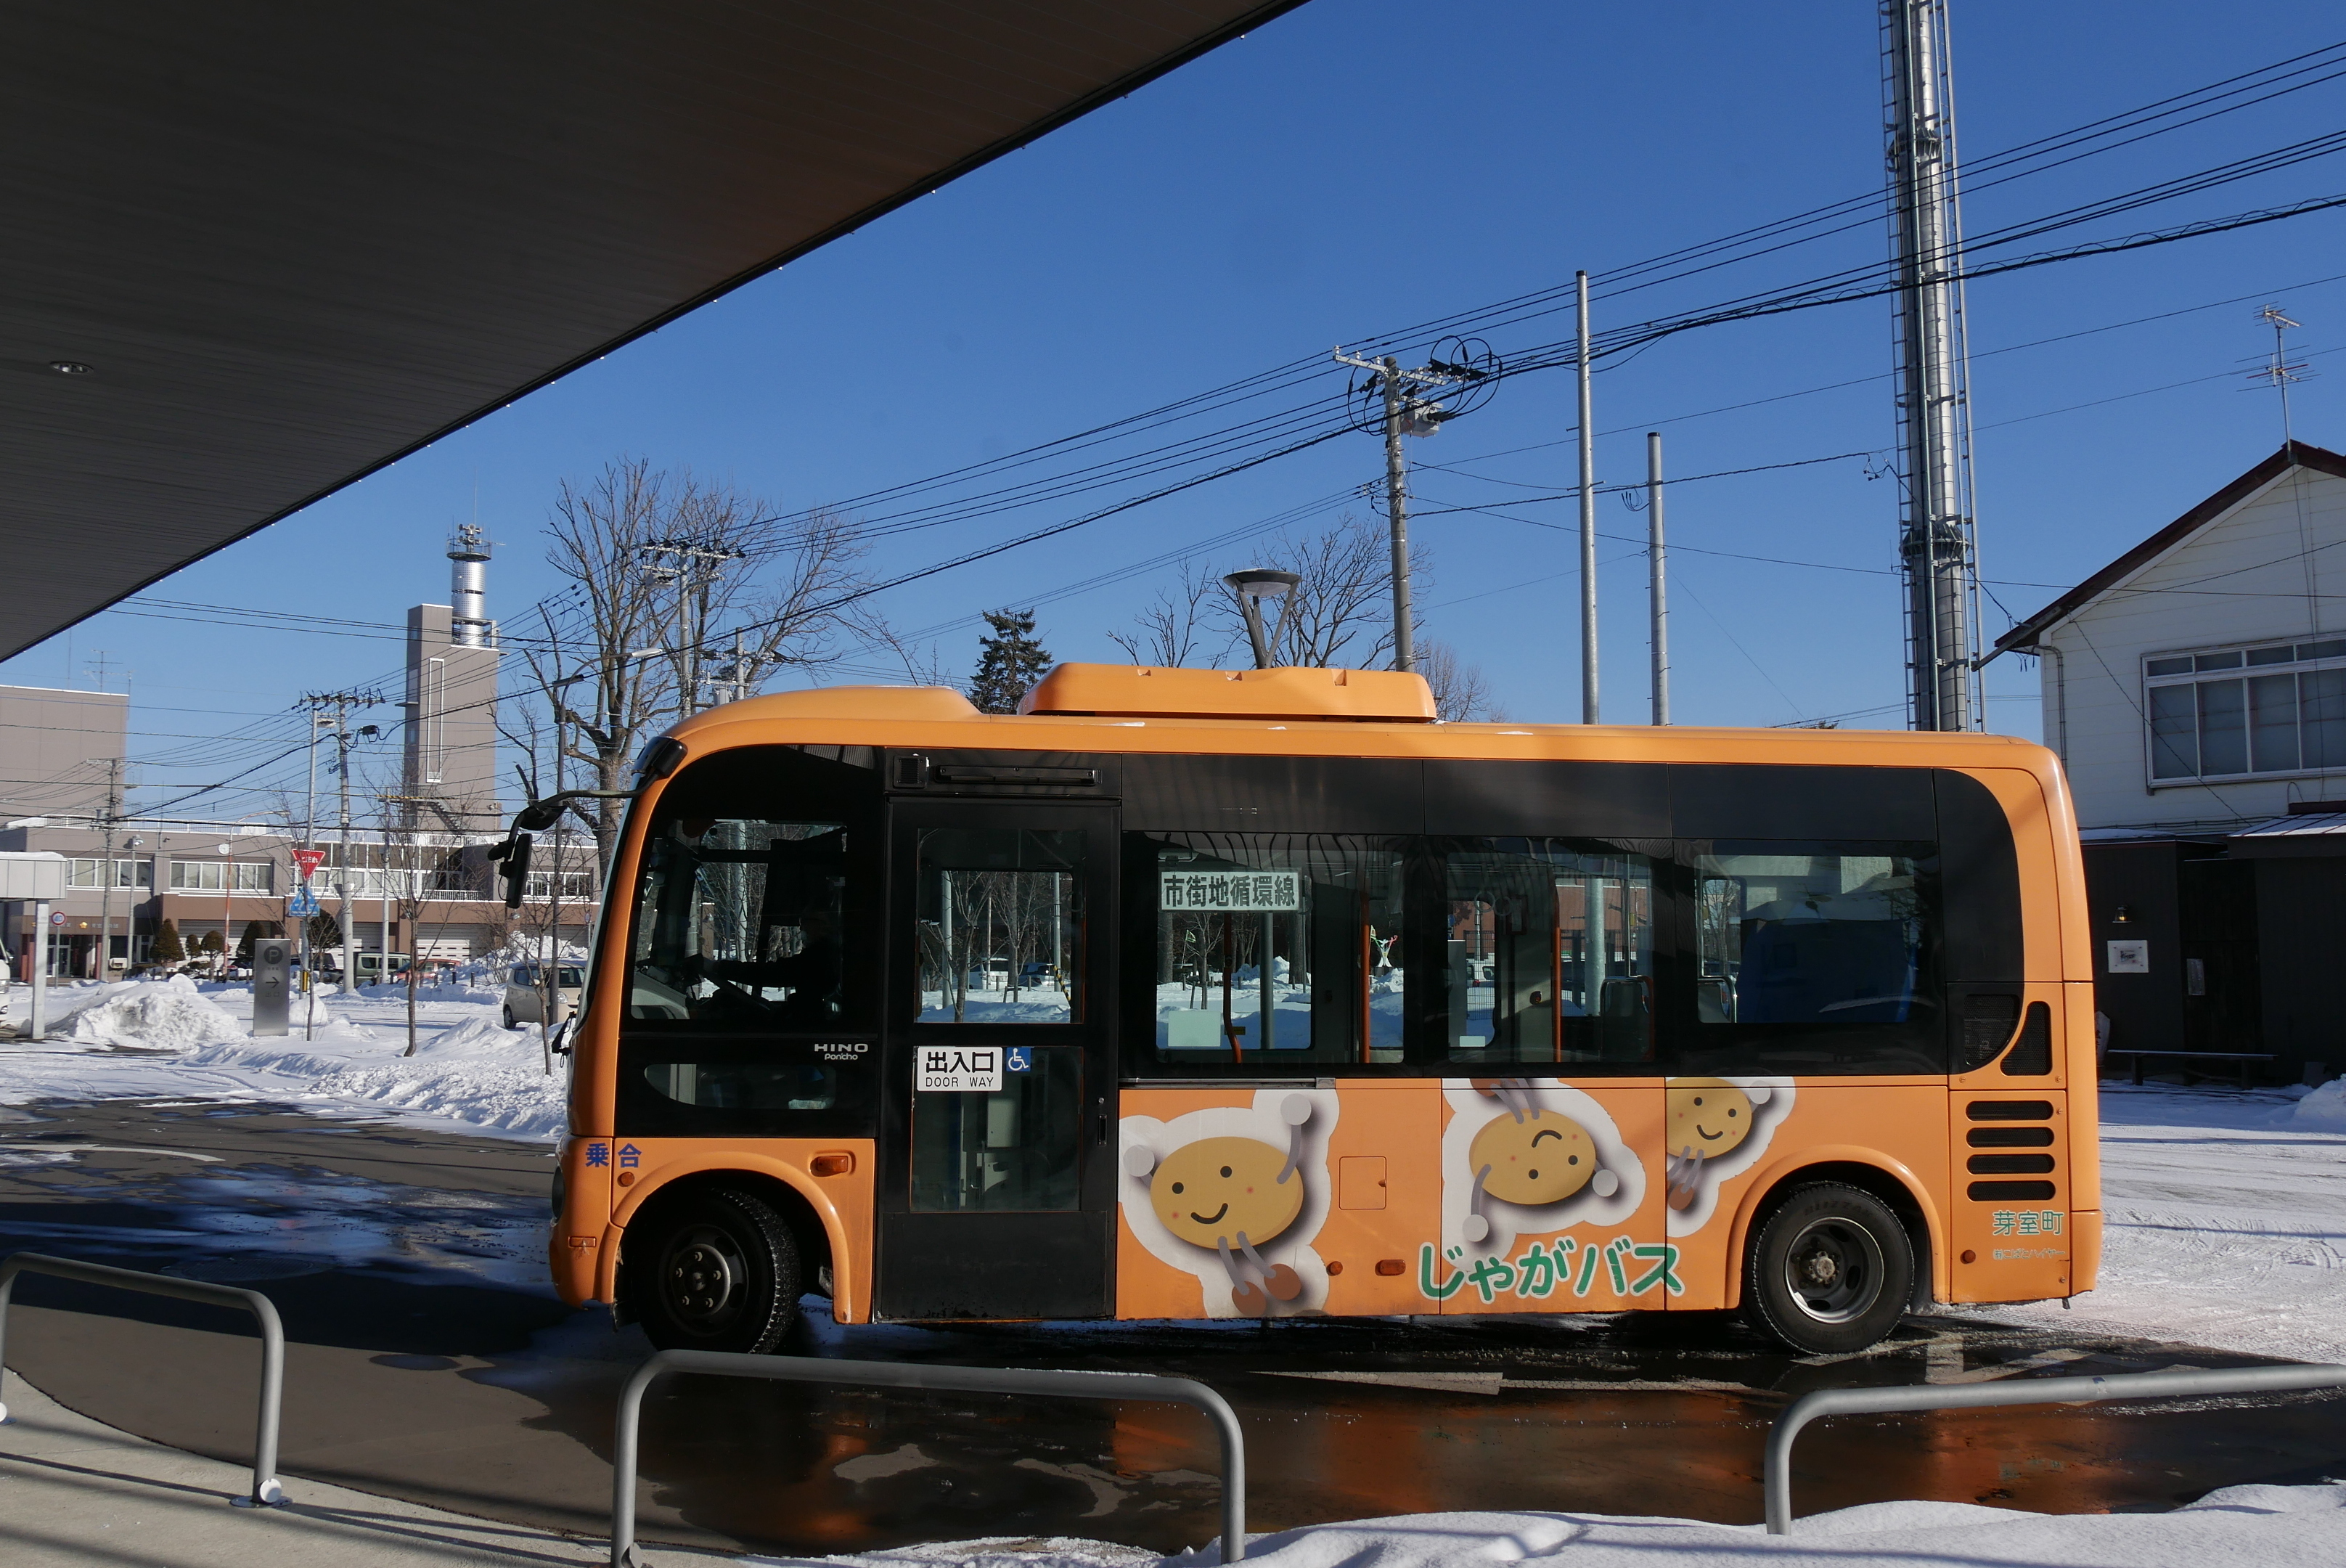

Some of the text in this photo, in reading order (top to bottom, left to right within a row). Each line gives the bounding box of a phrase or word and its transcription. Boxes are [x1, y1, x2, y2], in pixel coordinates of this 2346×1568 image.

[1164, 874, 1296, 907] 市街地循環線
[814, 1043, 869, 1053] HINO
[925, 1051, 994, 1074] 出入口
[925, 1077, 994, 1087] DOOR WAY
[585, 1143, 643, 1168] 乗合
[1993, 1209, 2065, 1236] 芽室町
[1418, 1235, 1685, 1304] じゃがバス
